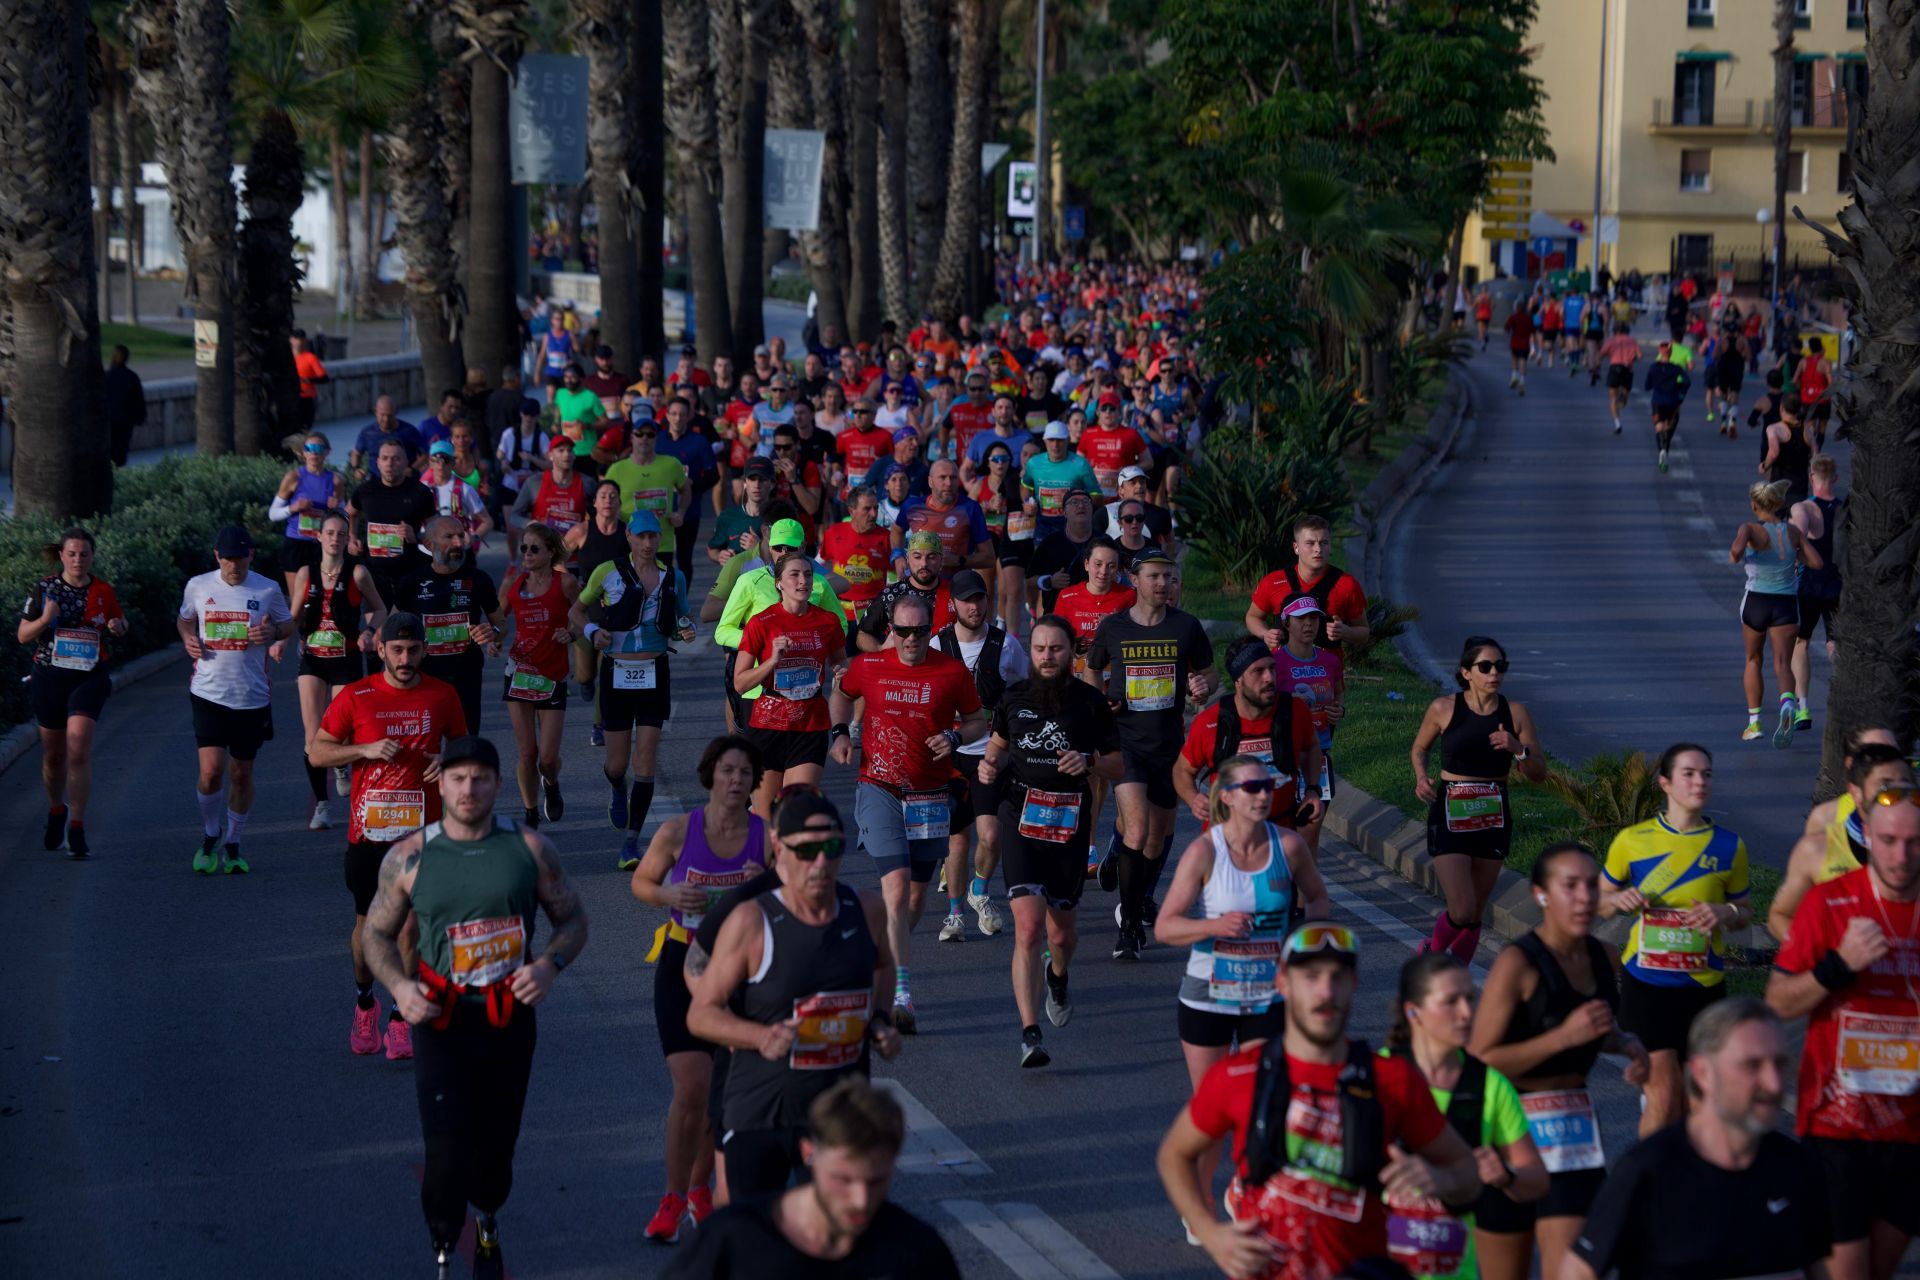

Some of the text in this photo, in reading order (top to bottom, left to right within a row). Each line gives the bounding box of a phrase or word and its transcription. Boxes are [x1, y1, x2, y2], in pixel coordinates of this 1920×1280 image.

[847, 554, 869, 566] 42
[215, 625, 238, 633] 3450
[625, 669, 646, 679] 322
[885, 690, 919, 704] MÁLAGA
[386, 710, 419, 718] GENERALI
[386, 723, 420, 736] MÁLAGA
[381, 793, 419, 802] GENERALI
[1462, 800, 1488, 810] 1385
[377, 808, 411, 820] 12941
[1038, 808, 1064, 818] 3599
